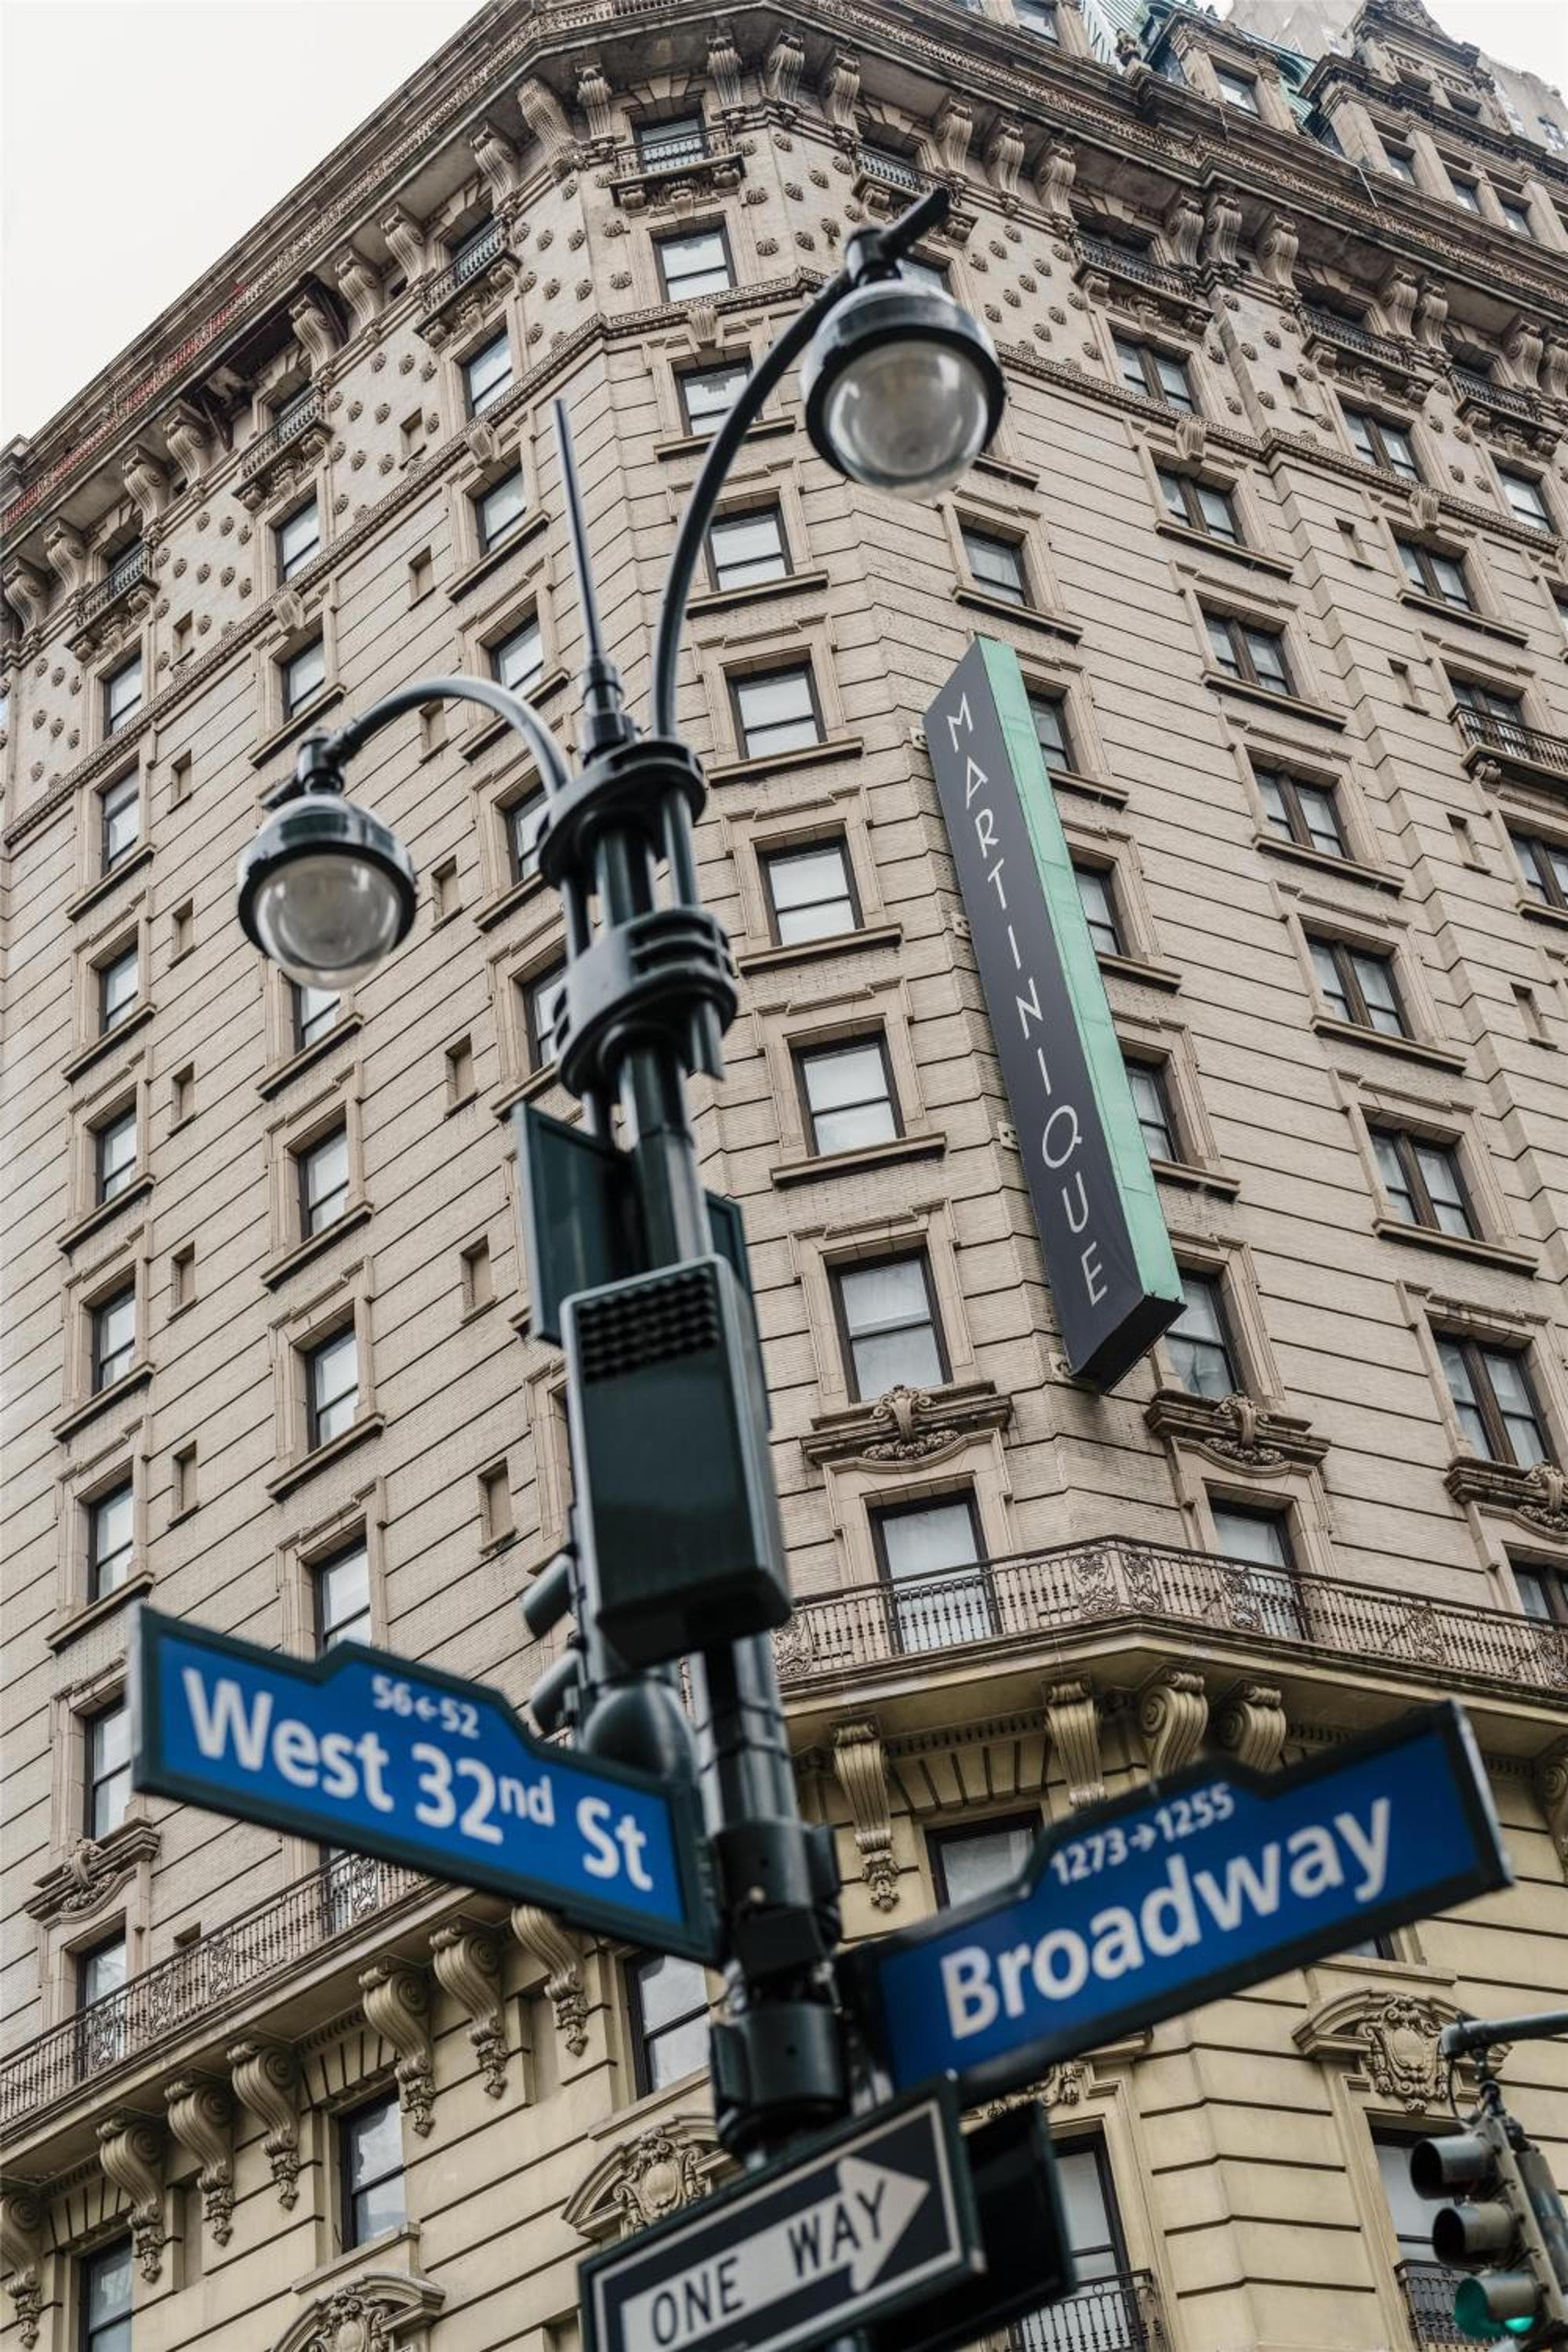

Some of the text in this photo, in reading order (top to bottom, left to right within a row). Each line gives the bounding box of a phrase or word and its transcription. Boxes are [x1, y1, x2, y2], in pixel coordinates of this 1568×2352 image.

[946, 691, 1109, 1306] MARTINIQUE
[182, 1668, 652, 1892] West 32nd St
[372, 1675, 481, 1740] 56 52
[941, 1798, 1392, 2041] Broadway
[1051, 1784, 1235, 1885] 1273 1255
[651, 2181, 887, 2344] ONE WAY
